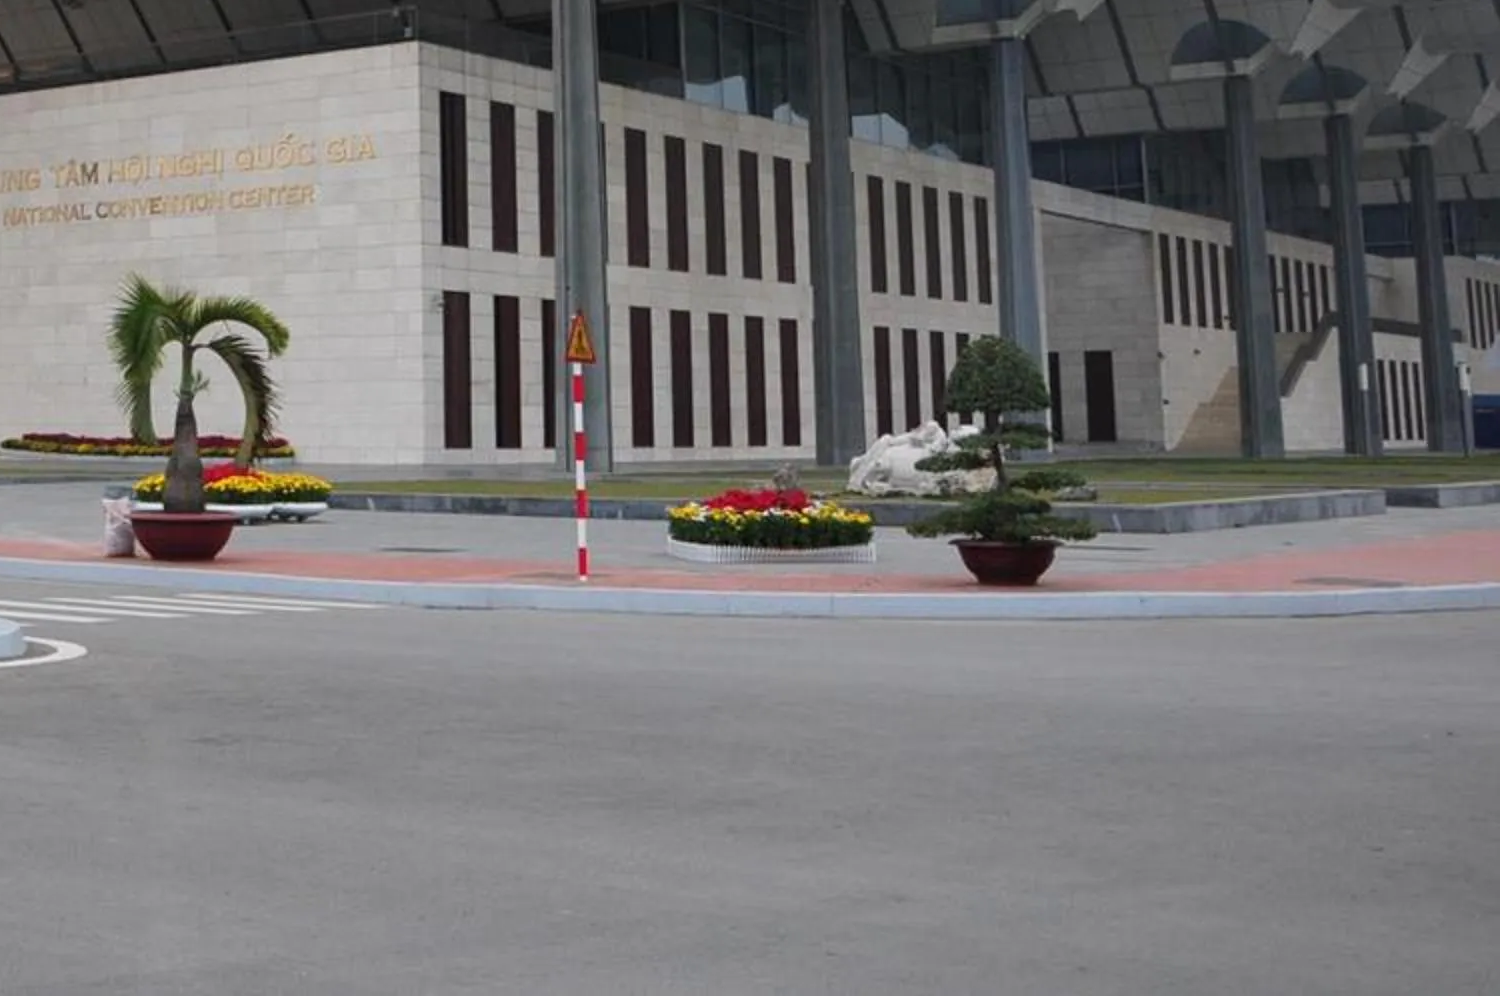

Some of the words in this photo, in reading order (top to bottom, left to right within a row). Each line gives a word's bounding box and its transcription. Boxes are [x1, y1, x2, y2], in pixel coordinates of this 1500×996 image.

[49, 157, 100, 189] TÂM
[236, 132, 317, 171] QUỐC
[324, 134, 376, 163] GIA
[3, 203, 92, 227] NATIONAL
[96, 190, 222, 218] CONVENTION
[229, 183, 316, 209] CENTER
